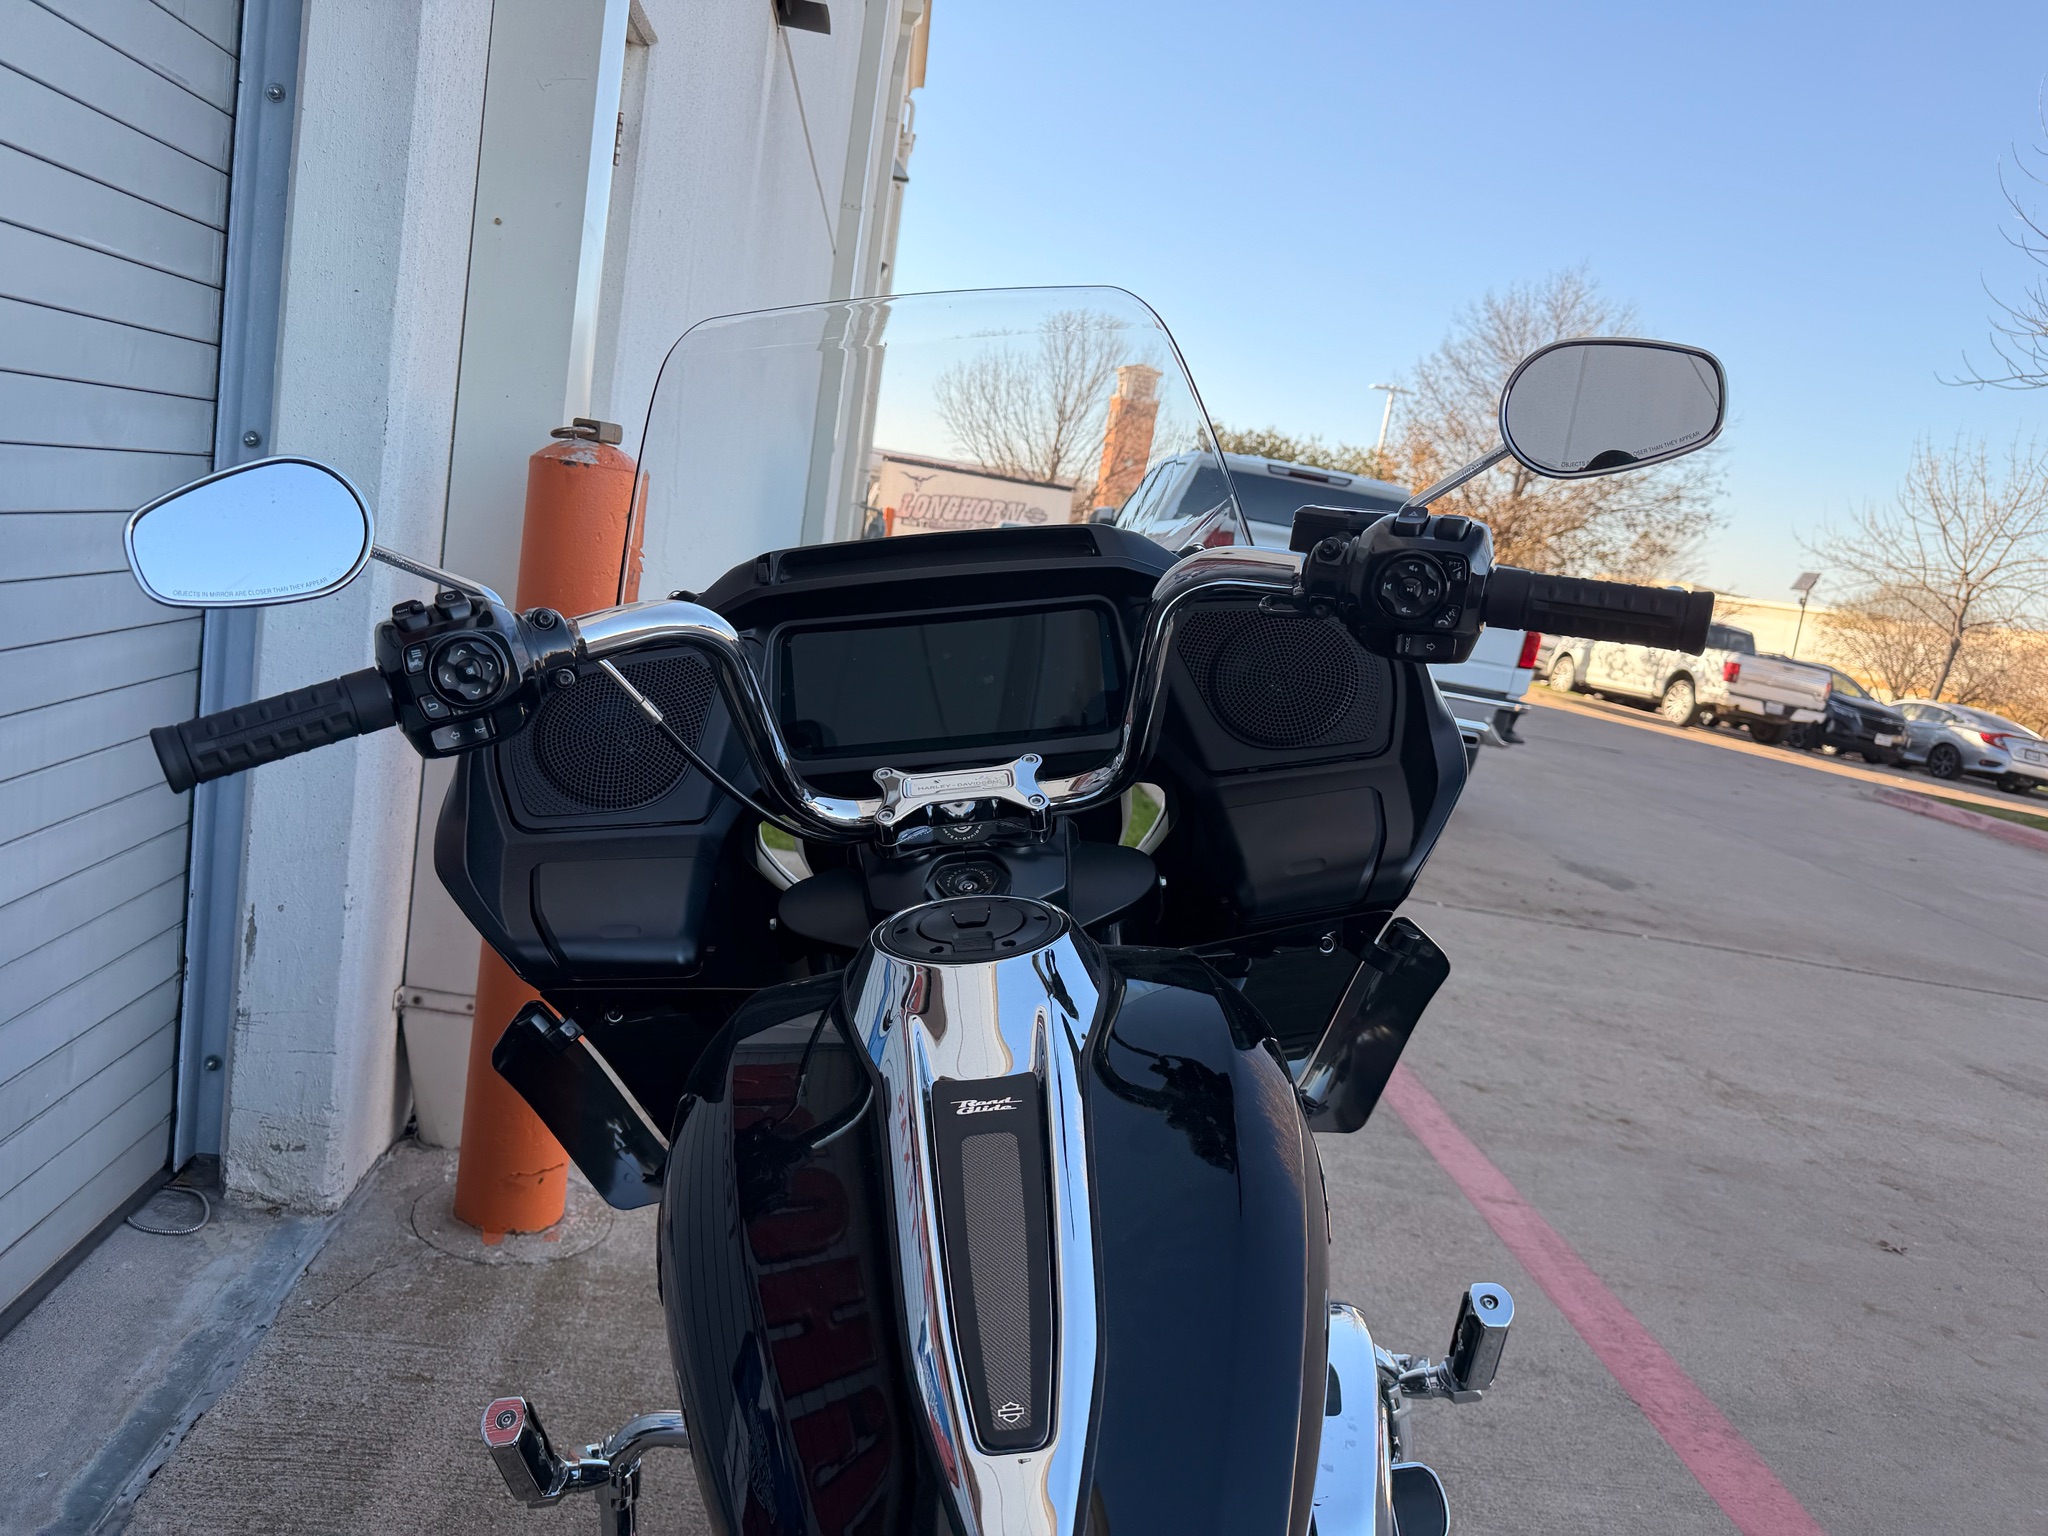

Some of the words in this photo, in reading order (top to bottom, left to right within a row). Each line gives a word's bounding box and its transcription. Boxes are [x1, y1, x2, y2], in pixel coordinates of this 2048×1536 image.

[1648, 443, 1663, 452] THAN
[1664, 439, 1678, 448] THEY
[1679, 431, 1701, 443] APPEAR
[895, 492, 1027, 524] LONGHORN
[172, 589, 201, 598] OBJECTS
[247, 587, 272, 596] CLOSER
[273, 585, 288, 593] THAN
[289, 582, 304, 591] THEY
[305, 576, 328, 588] APPEAR
[951, 1096, 1022, 1109] Road
[956, 1104, 1017, 1115] Glide
